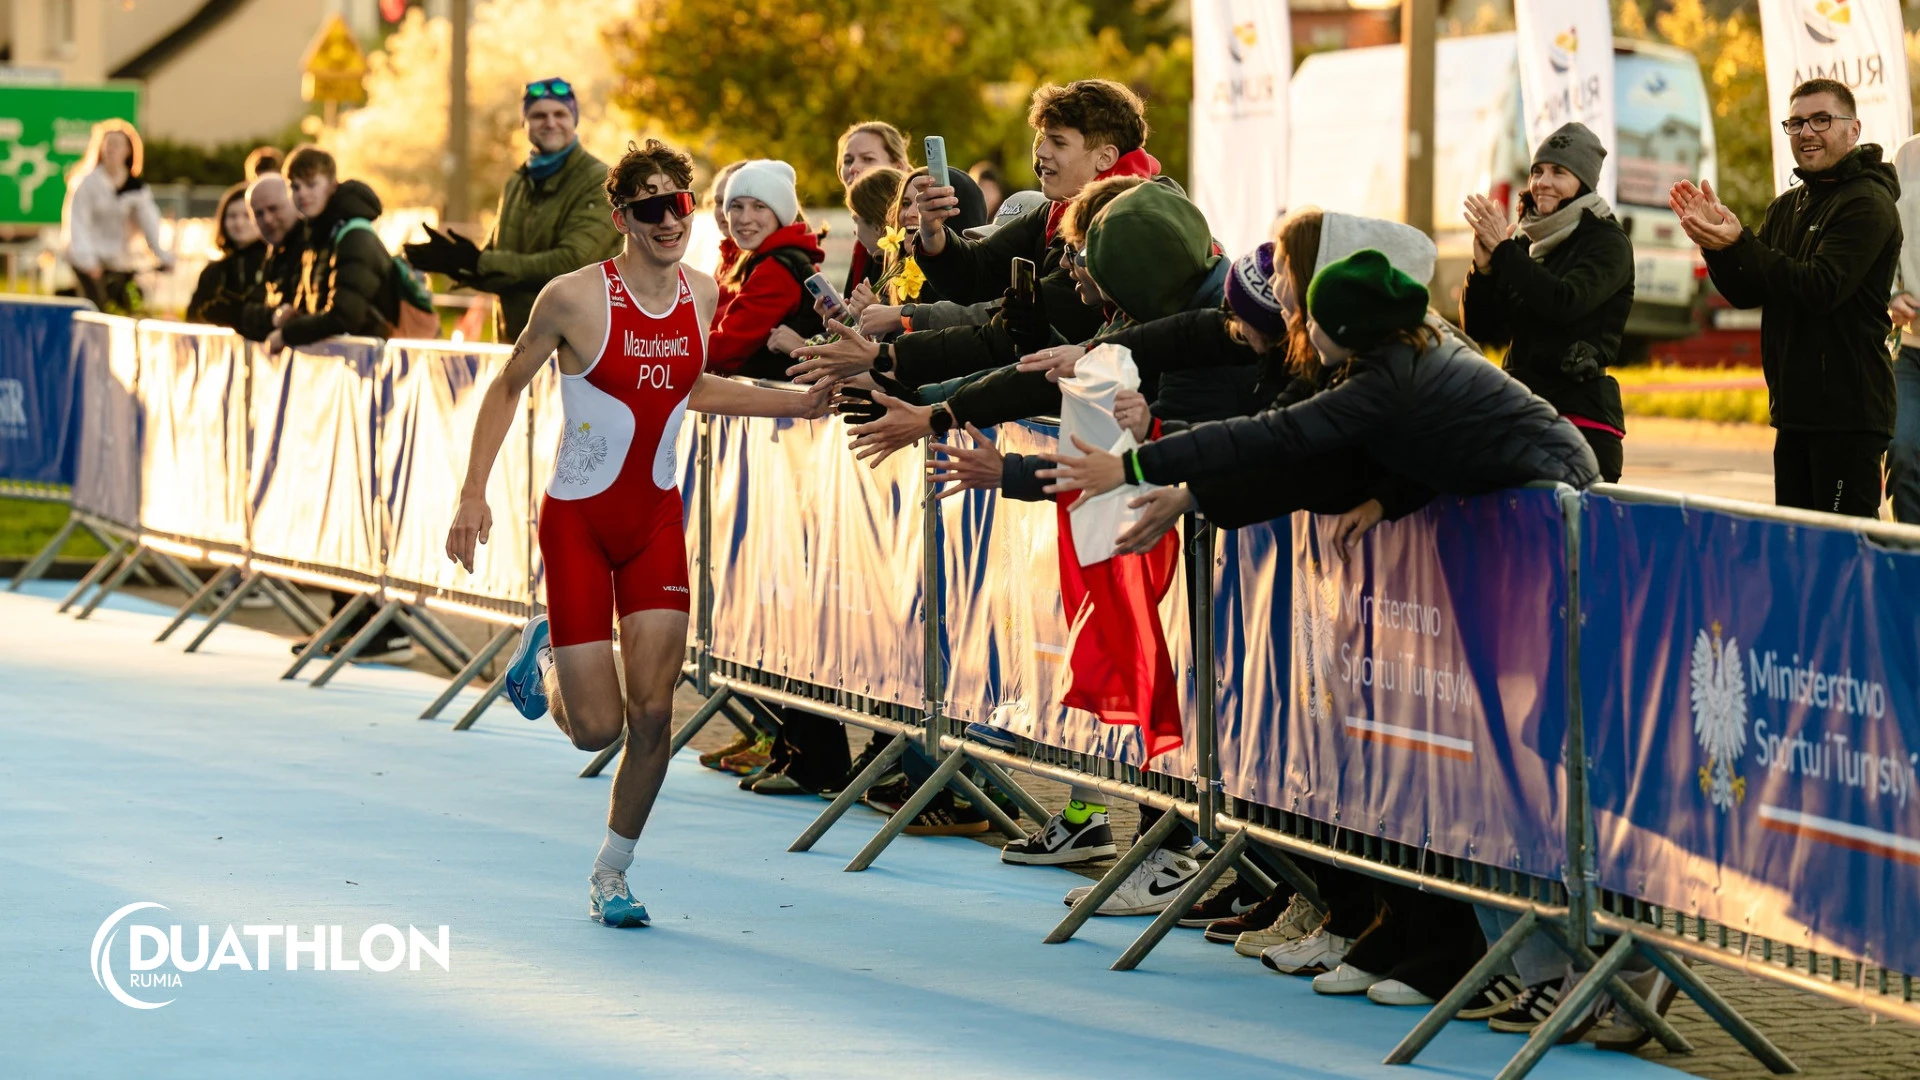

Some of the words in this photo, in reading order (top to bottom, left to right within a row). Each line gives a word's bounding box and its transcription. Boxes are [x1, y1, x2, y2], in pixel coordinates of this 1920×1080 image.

[1244, 264, 1281, 305] CZE
[623, 329, 690, 358] Mazurkiewicz
[636, 364, 674, 390] POL
[1833, 479, 1844, 512] MILO
[1340, 582, 1441, 637] Minsterstwo
[1749, 648, 1886, 720] Ministerstwo
[1754, 717, 1821, 780] Sportu
